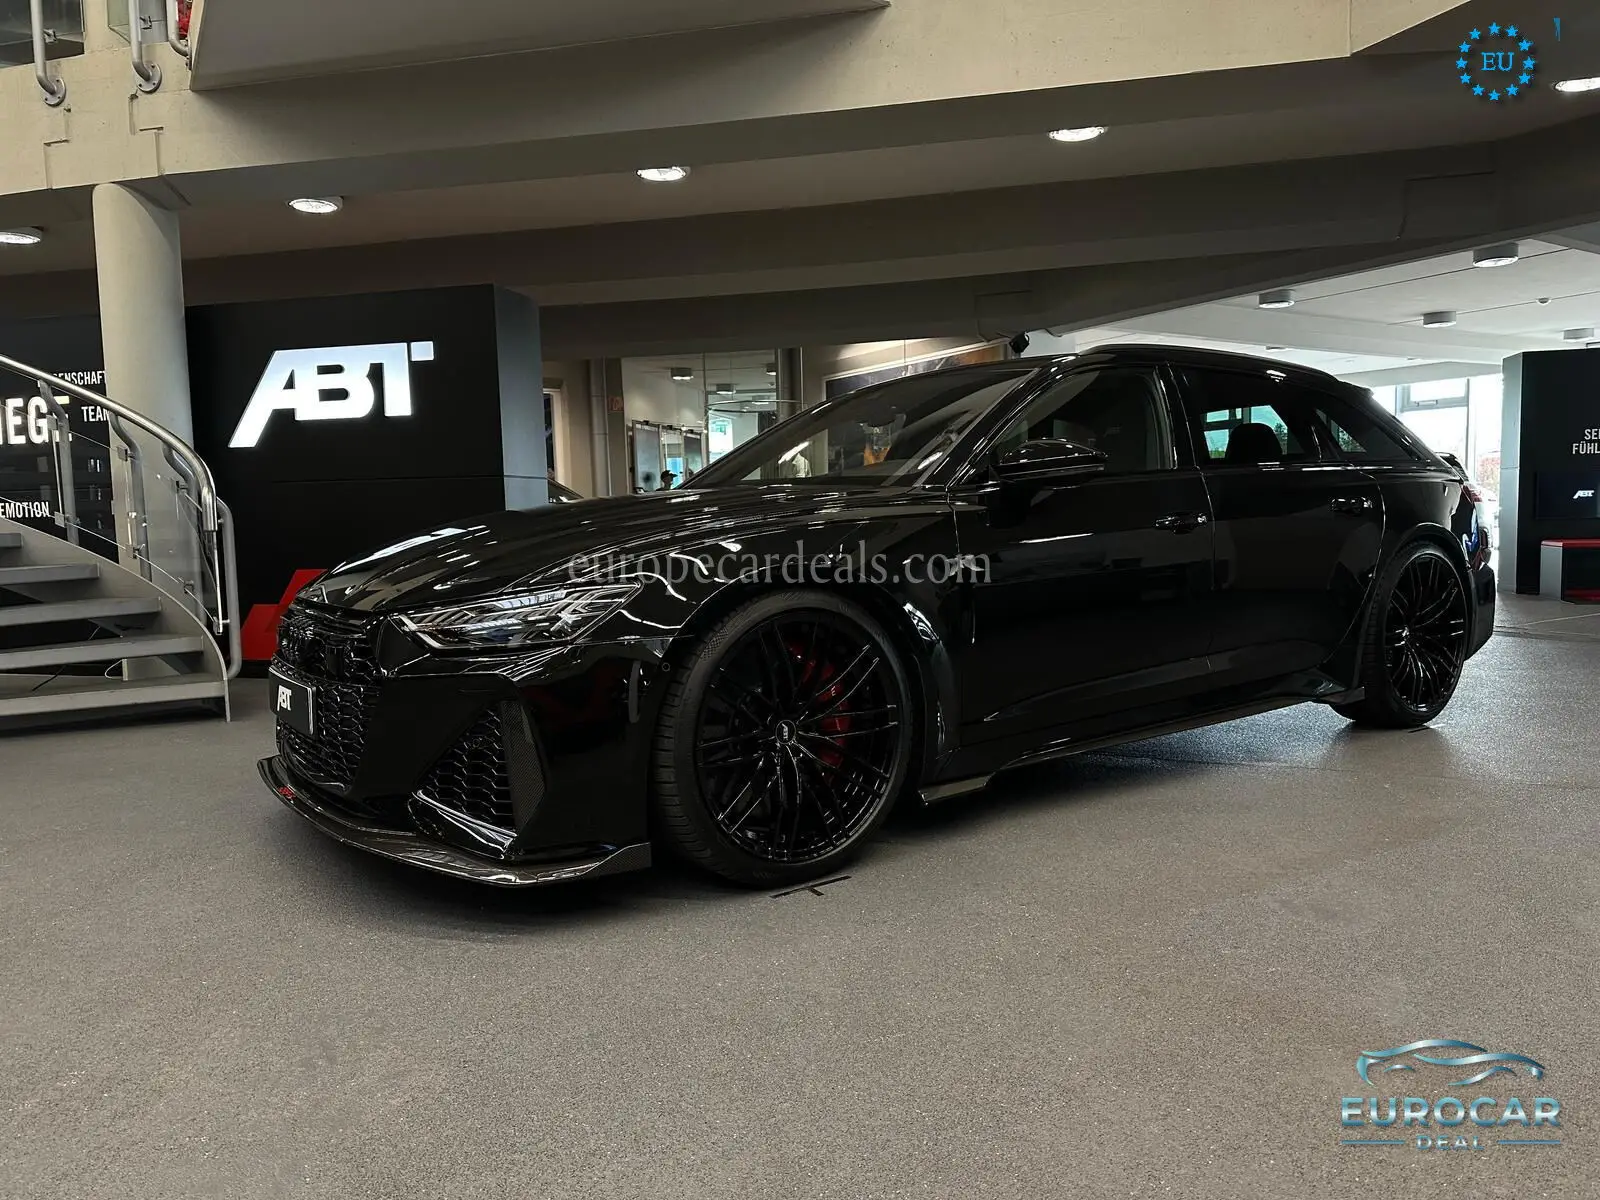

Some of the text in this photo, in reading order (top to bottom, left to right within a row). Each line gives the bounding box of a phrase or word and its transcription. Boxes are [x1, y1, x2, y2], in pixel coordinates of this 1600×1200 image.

[228, 341, 434, 448] ABT
[1584, 428, 1600, 440] SE
[1572, 490, 1595, 499] ABT
[0, 501, 49, 518] EMOTION
[277, 685, 292, 712] ABT
